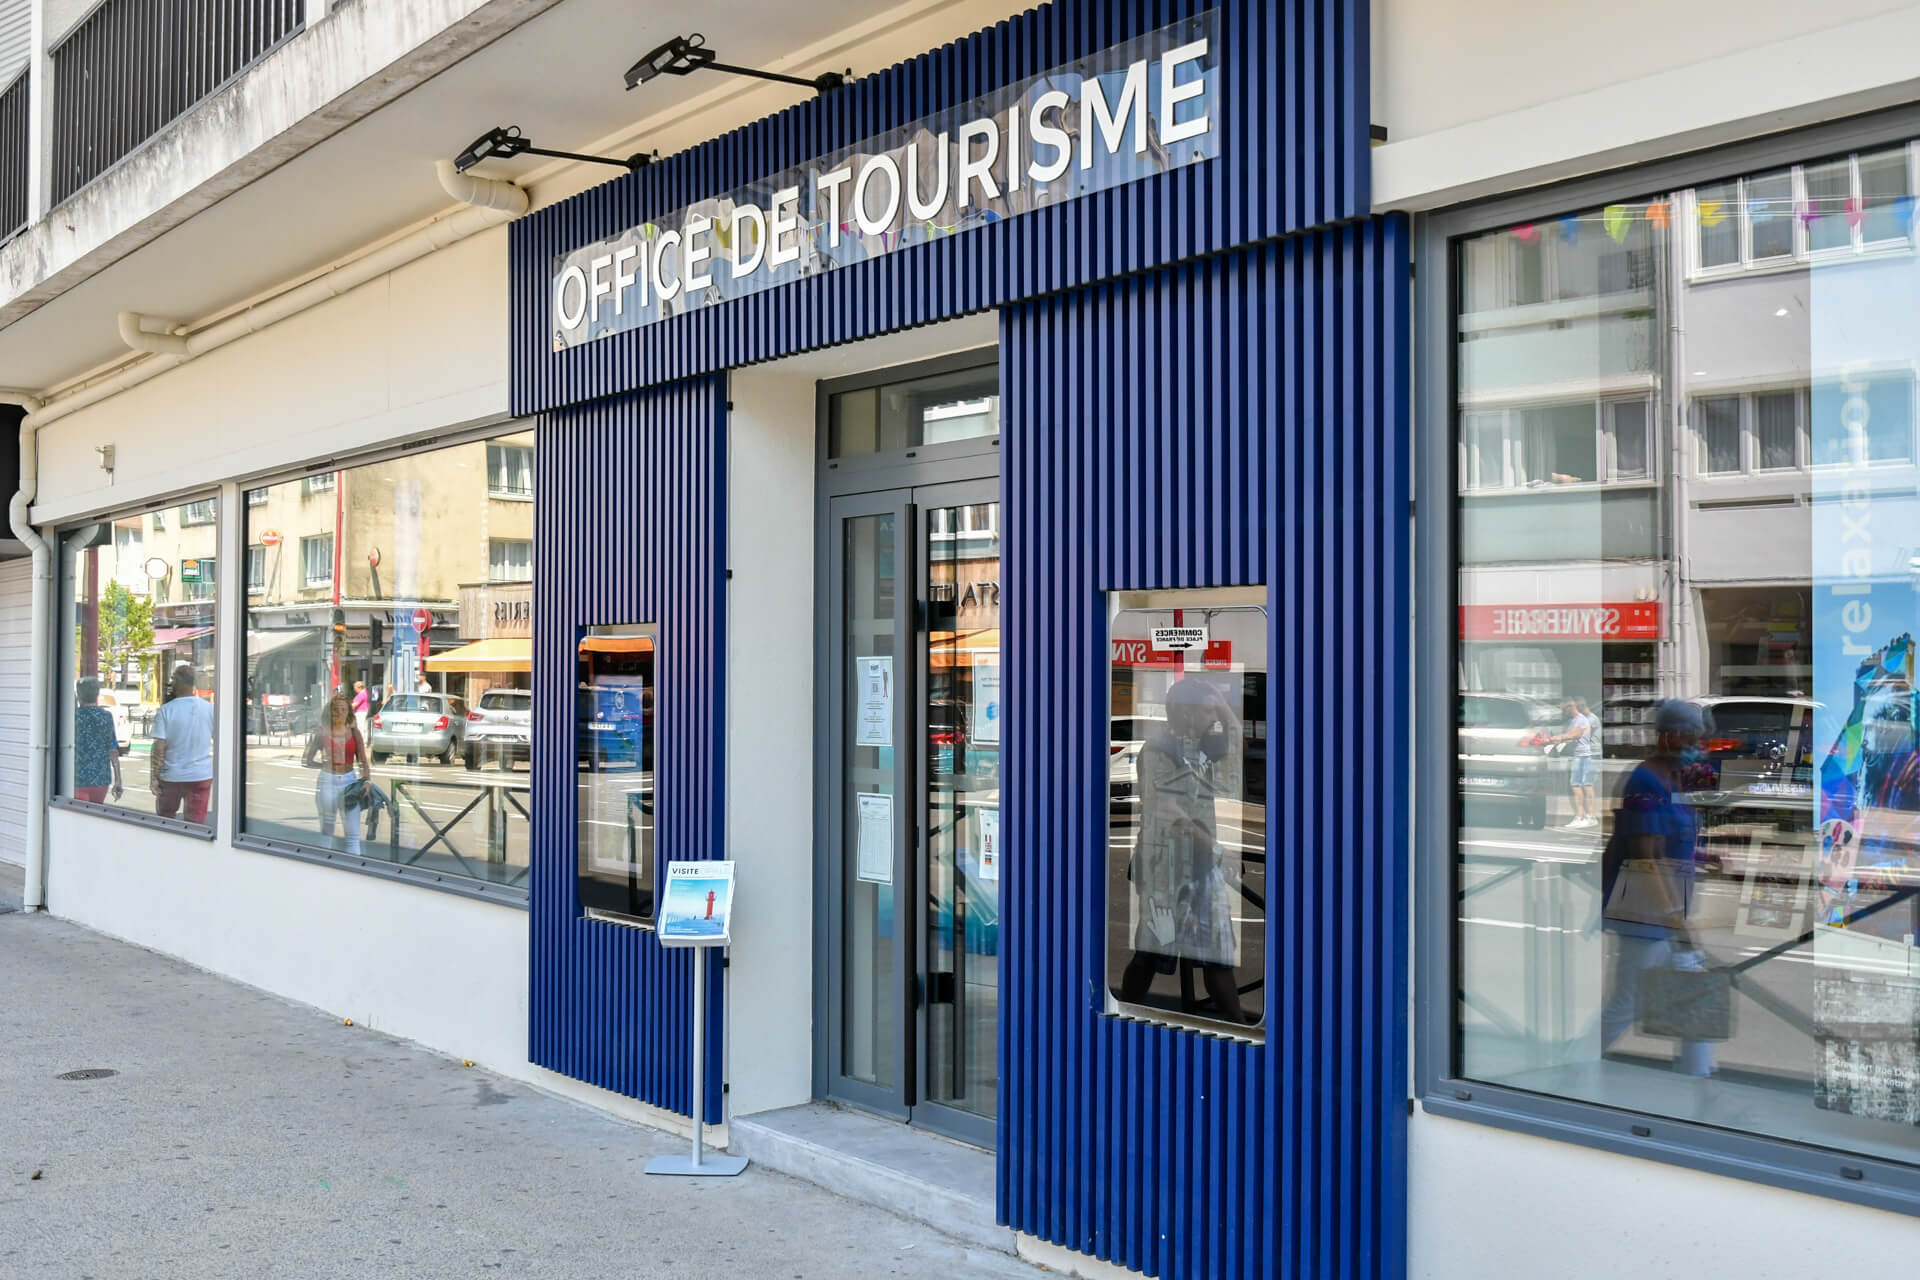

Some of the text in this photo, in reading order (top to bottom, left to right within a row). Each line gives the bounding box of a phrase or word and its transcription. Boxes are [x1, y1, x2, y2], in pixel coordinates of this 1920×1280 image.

[556, 37, 1212, 331] OFFICE DE TOURISME
